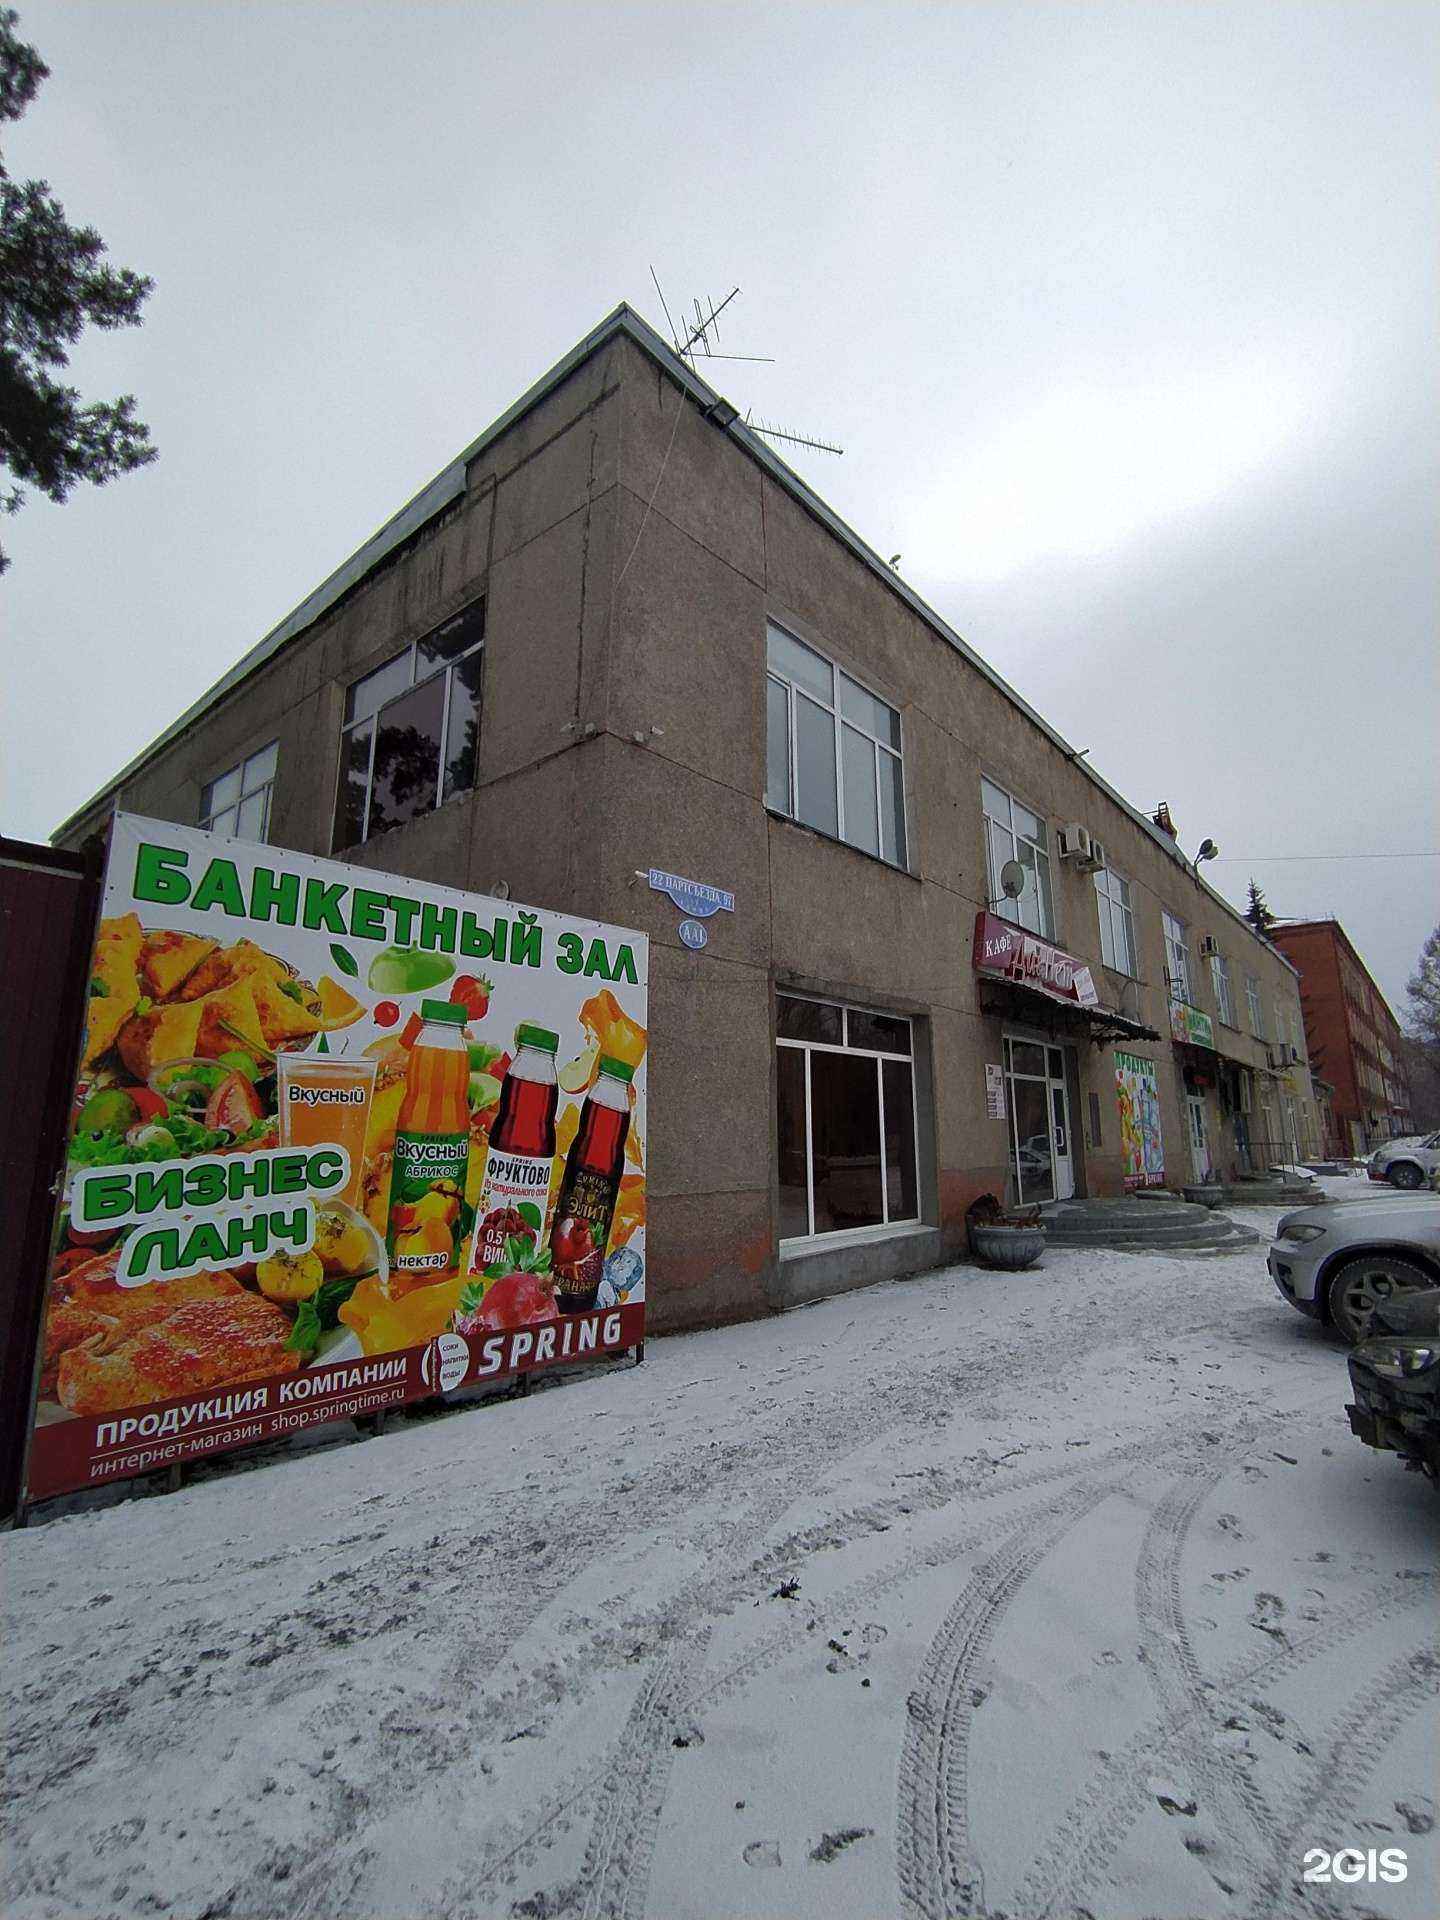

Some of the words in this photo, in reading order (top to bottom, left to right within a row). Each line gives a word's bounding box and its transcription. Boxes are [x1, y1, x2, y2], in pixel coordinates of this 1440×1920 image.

[132, 842, 545, 969] БАНКЕТНЫЙ
[556, 931, 639, 985] ЗАЛ
[985, 934, 1012, 958] КАФЕ
[288, 1084, 365, 1105] Вкусный
[396, 1138, 469, 1163] Вкусный
[404, 1165, 460, 1177] АБРИКОС
[487, 1157, 550, 1185] ФРУКТОВО
[83, 1151, 343, 1221] БИЗНЕС
[125, 1208, 308, 1278] ЛАНЧ
[398, 1252, 448, 1268] нектар
[478, 1312, 621, 1376] SPRING
[96, 1387, 268, 1448] ПРОДУКЦИЯ
[279, 1357, 407, 1404] КОМПАНИИ
[90, 1422, 262, 1478] интернет-магазин
[271, 1387, 405, 1432] shop.springtime.ru
